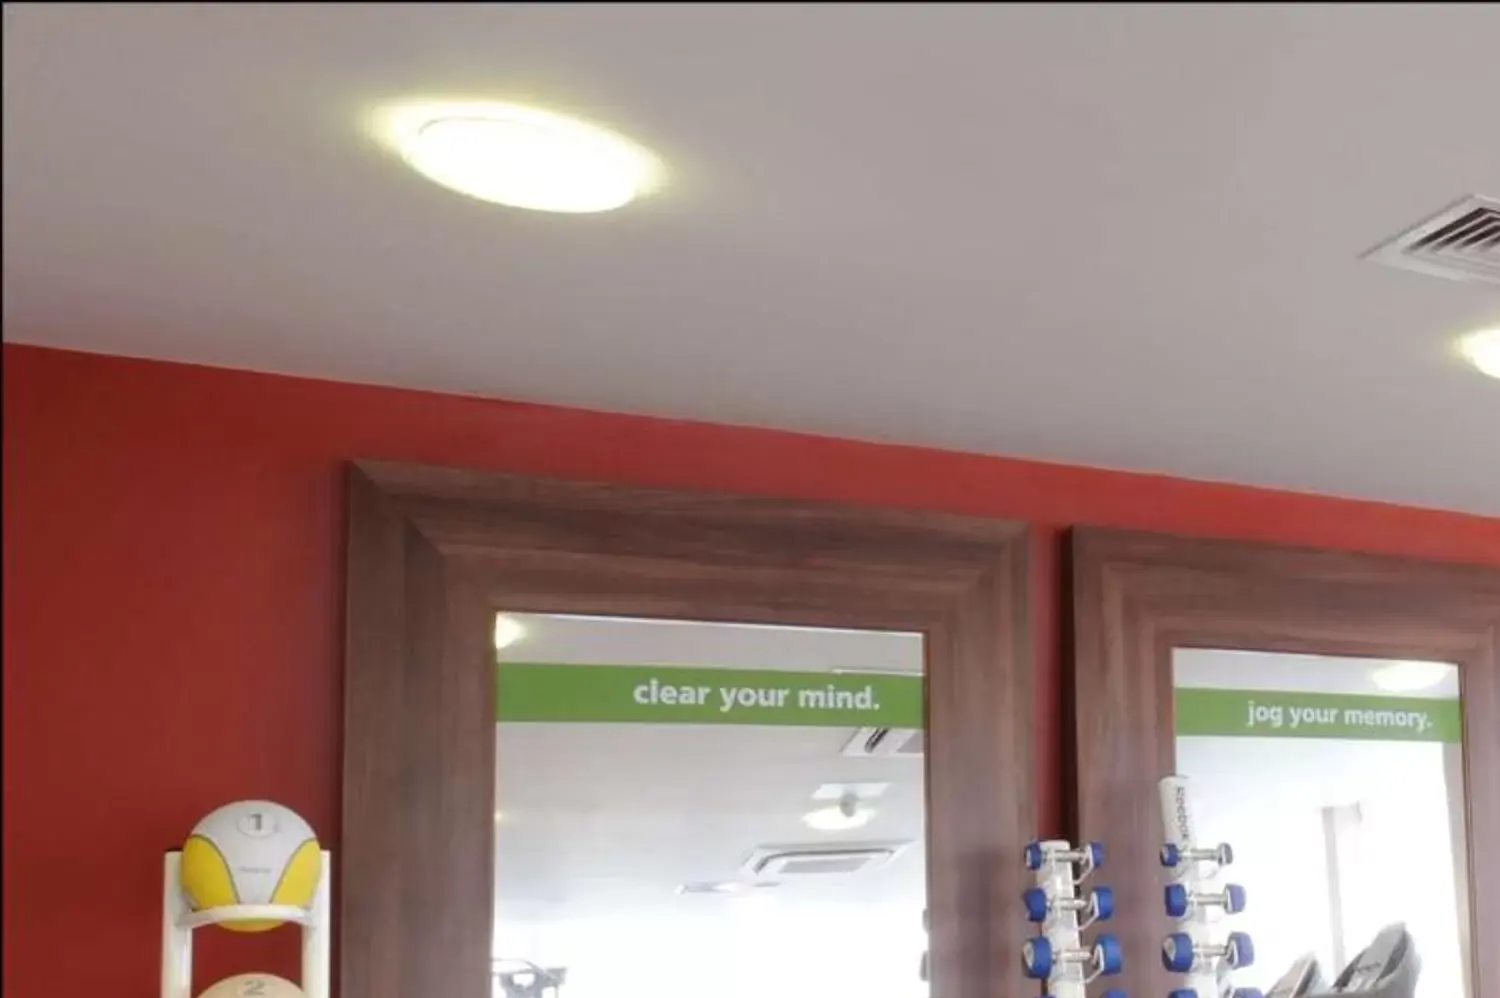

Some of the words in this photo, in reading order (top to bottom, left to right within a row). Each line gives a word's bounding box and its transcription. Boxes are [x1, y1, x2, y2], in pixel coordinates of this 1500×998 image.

[633, 678, 711, 705] clear
[719, 686, 790, 712] your
[798, 684, 880, 710] mind.
[1246, 700, 1283, 728] jog
[1289, 706, 1340, 729] your
[1344, 709, 1434, 734] memory.
[249, 813, 263, 831] 1
[244, 980, 265, 997] 2
